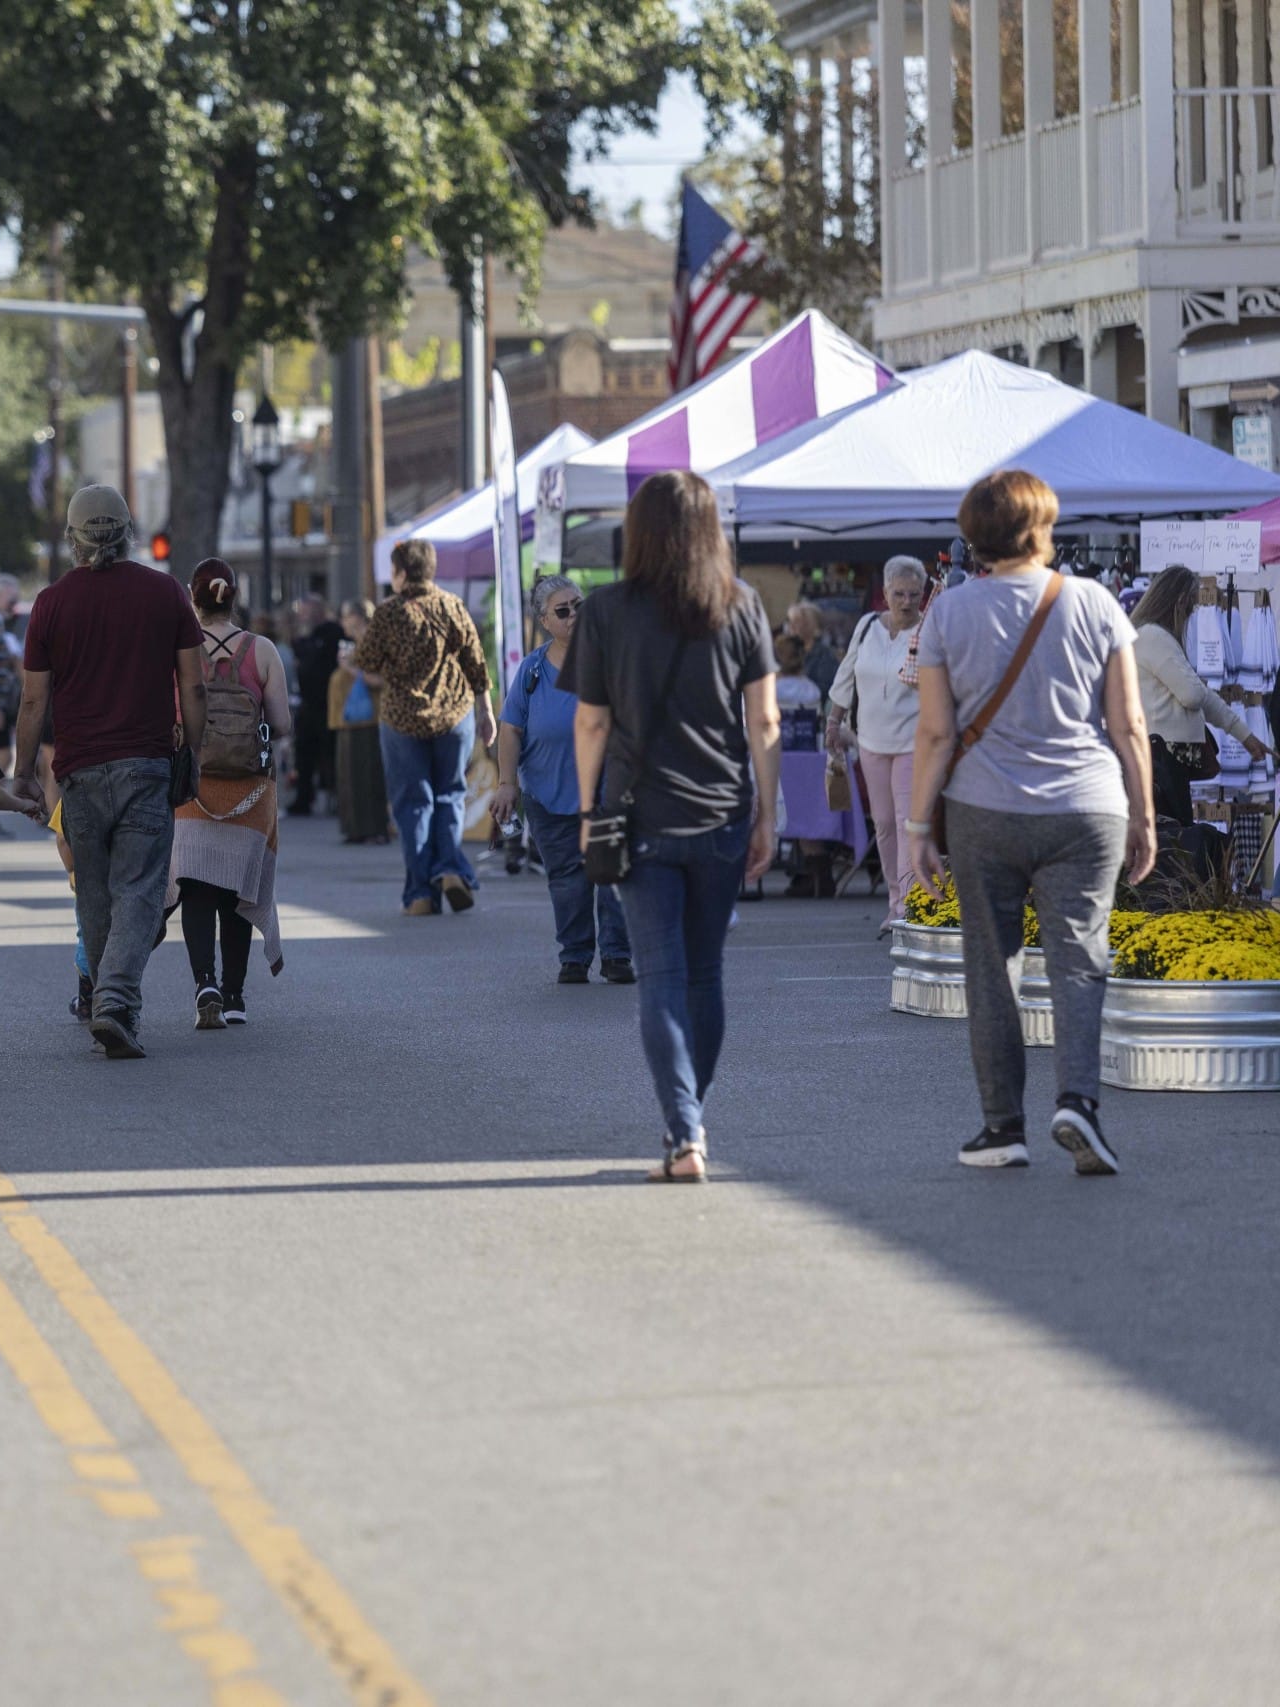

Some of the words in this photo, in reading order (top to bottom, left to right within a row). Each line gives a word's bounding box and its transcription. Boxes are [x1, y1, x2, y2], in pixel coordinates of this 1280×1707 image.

[1144, 535, 1162, 552] Tea
[1165, 535, 1202, 552] Towels
[1206, 535, 1222, 552] Tea
[1224, 535, 1257, 552] Towels
